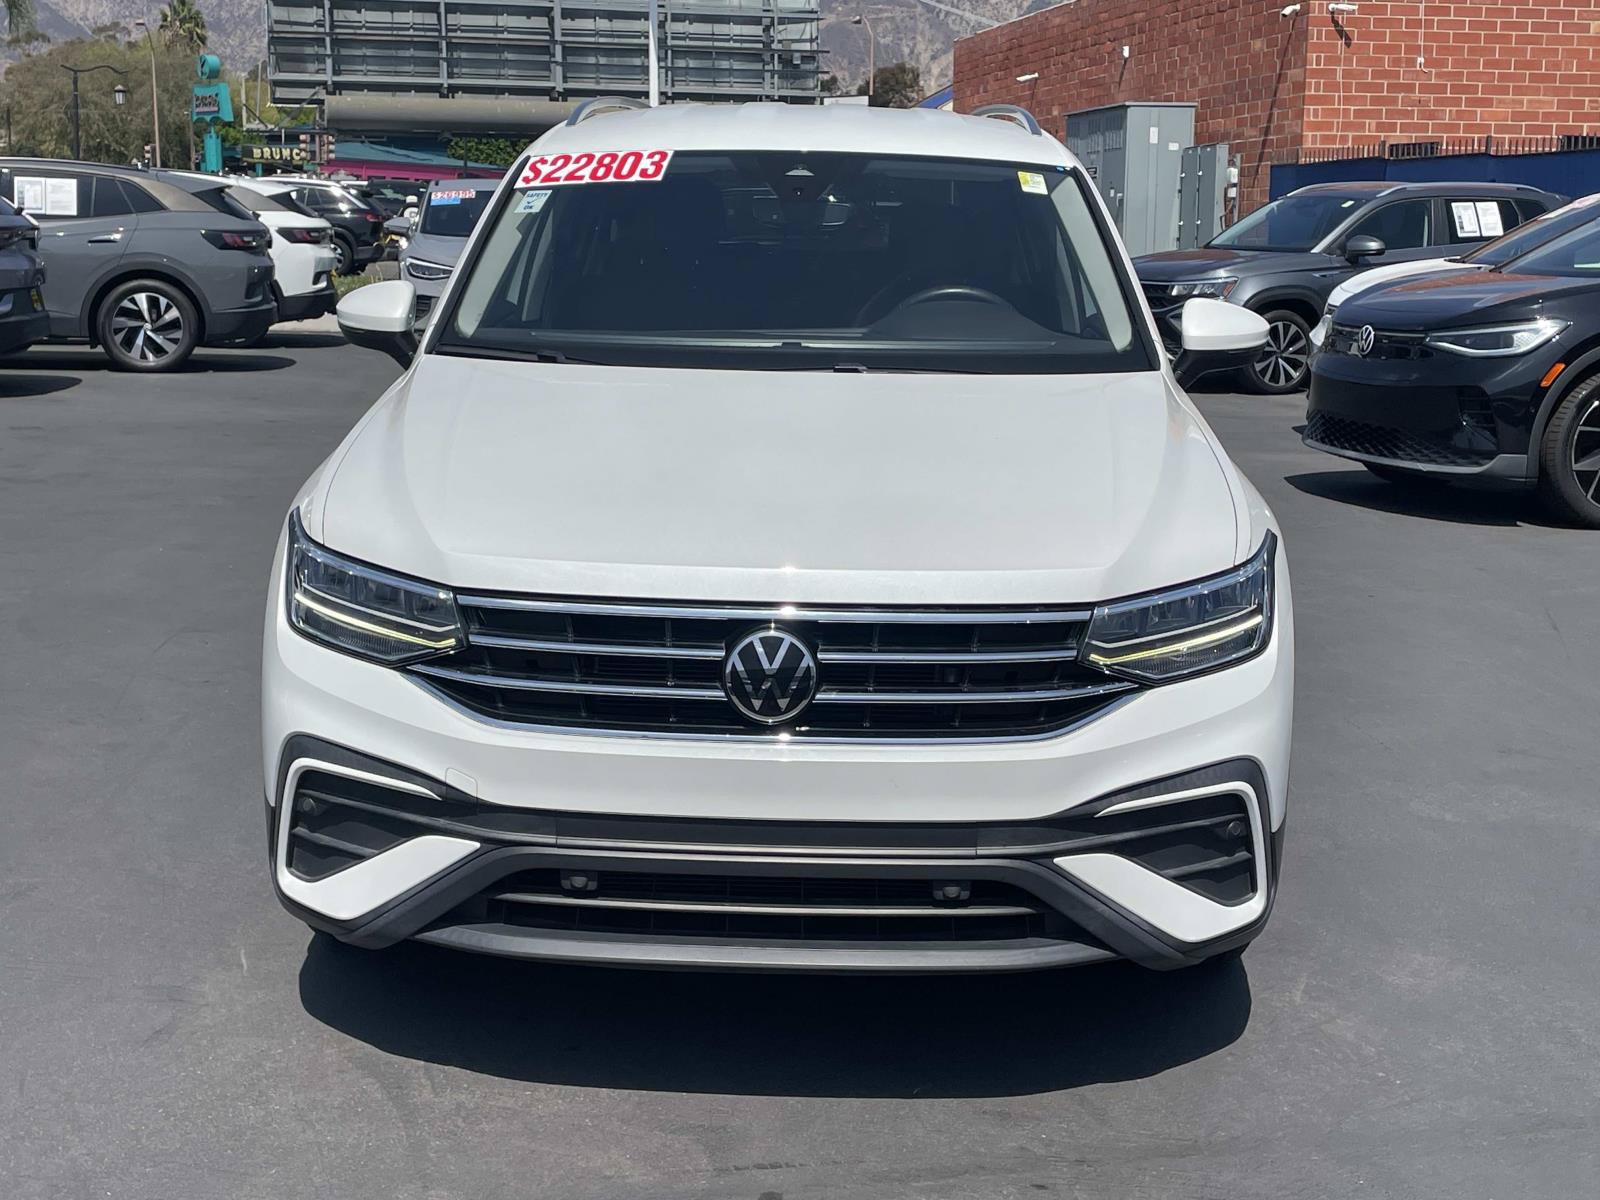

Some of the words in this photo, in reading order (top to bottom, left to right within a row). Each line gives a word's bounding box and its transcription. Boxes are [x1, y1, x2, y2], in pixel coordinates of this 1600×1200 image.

[253, 146, 301, 160] BRUNC
[521, 150, 668, 185] $22803
[727, 633, 813, 716] VW
